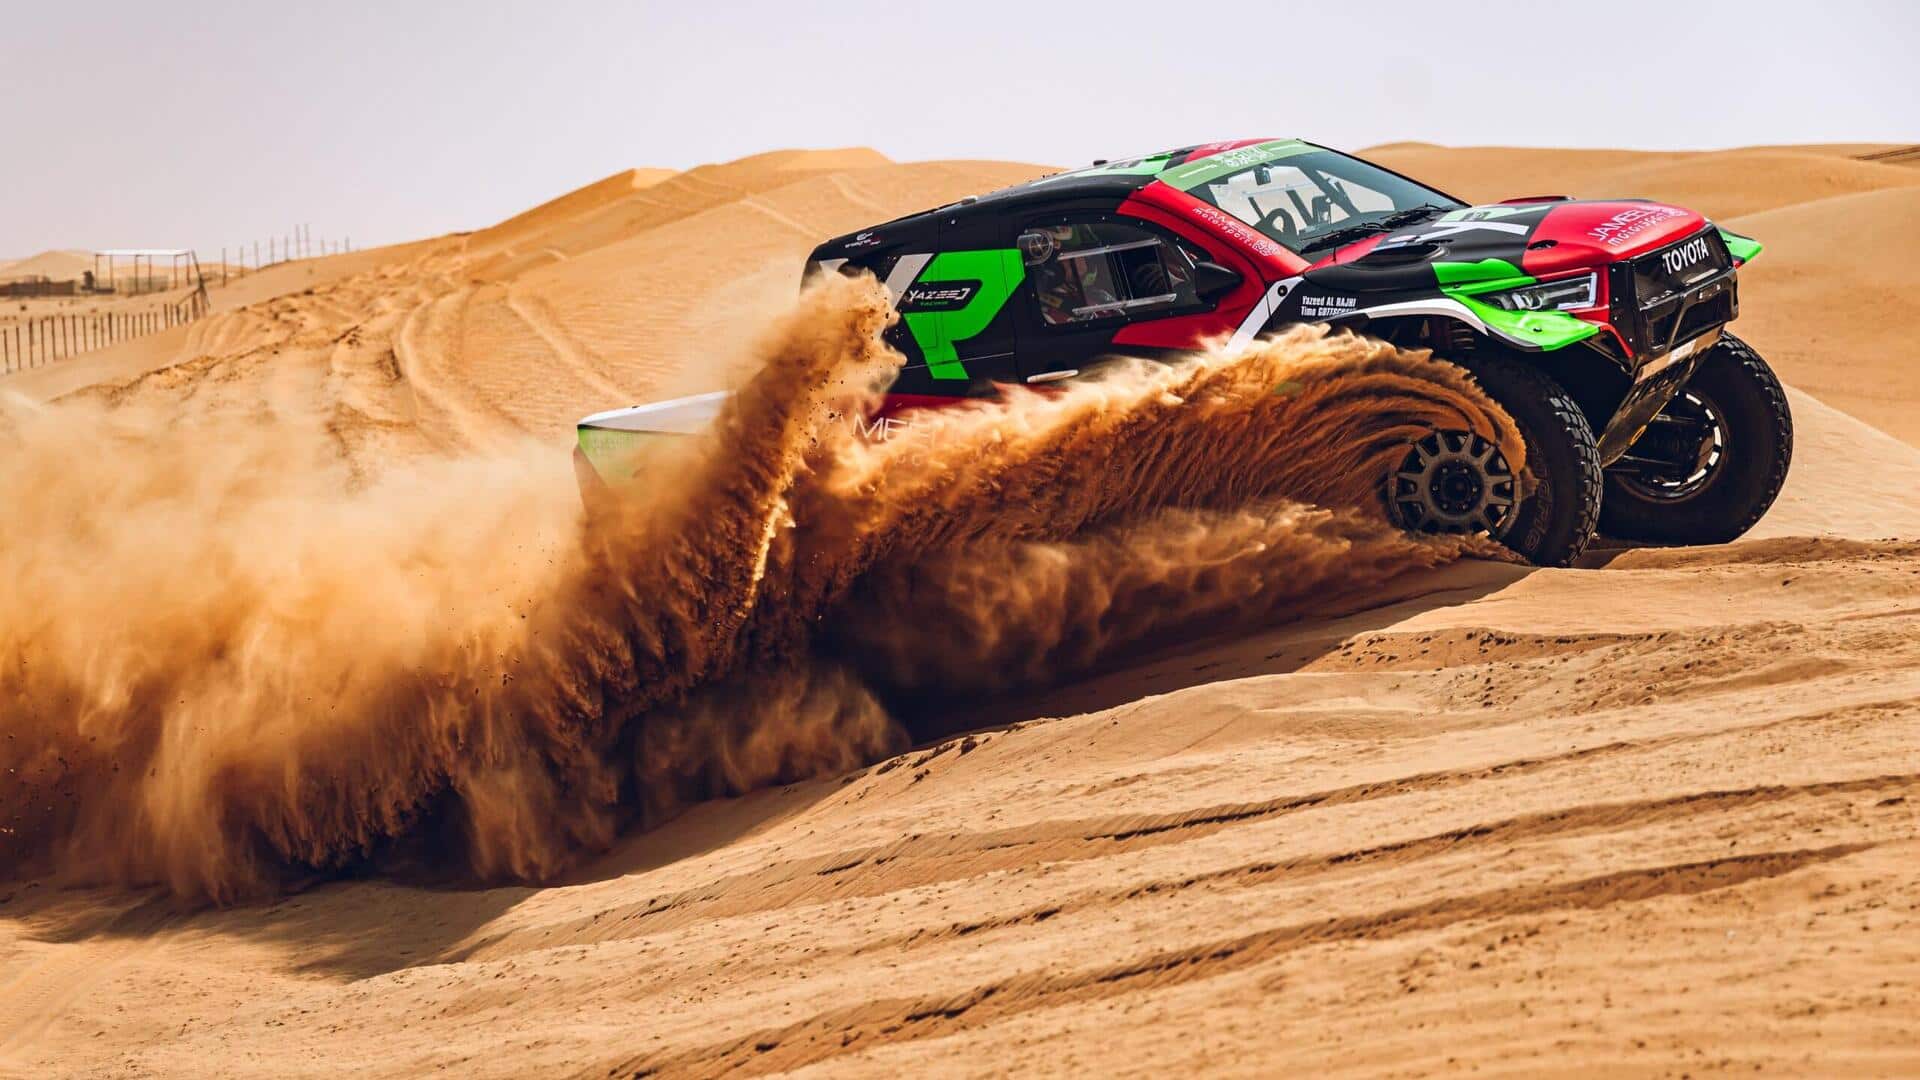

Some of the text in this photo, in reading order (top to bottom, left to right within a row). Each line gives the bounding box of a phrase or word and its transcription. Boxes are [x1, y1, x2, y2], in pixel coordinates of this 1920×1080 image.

[1587, 205, 1655, 241] JAMEEL
[1662, 236, 1709, 275] TOYOTA
[1301, 306, 1316, 316] Timo
[1302, 296, 1357, 307] Yazeed AL RAJHI
